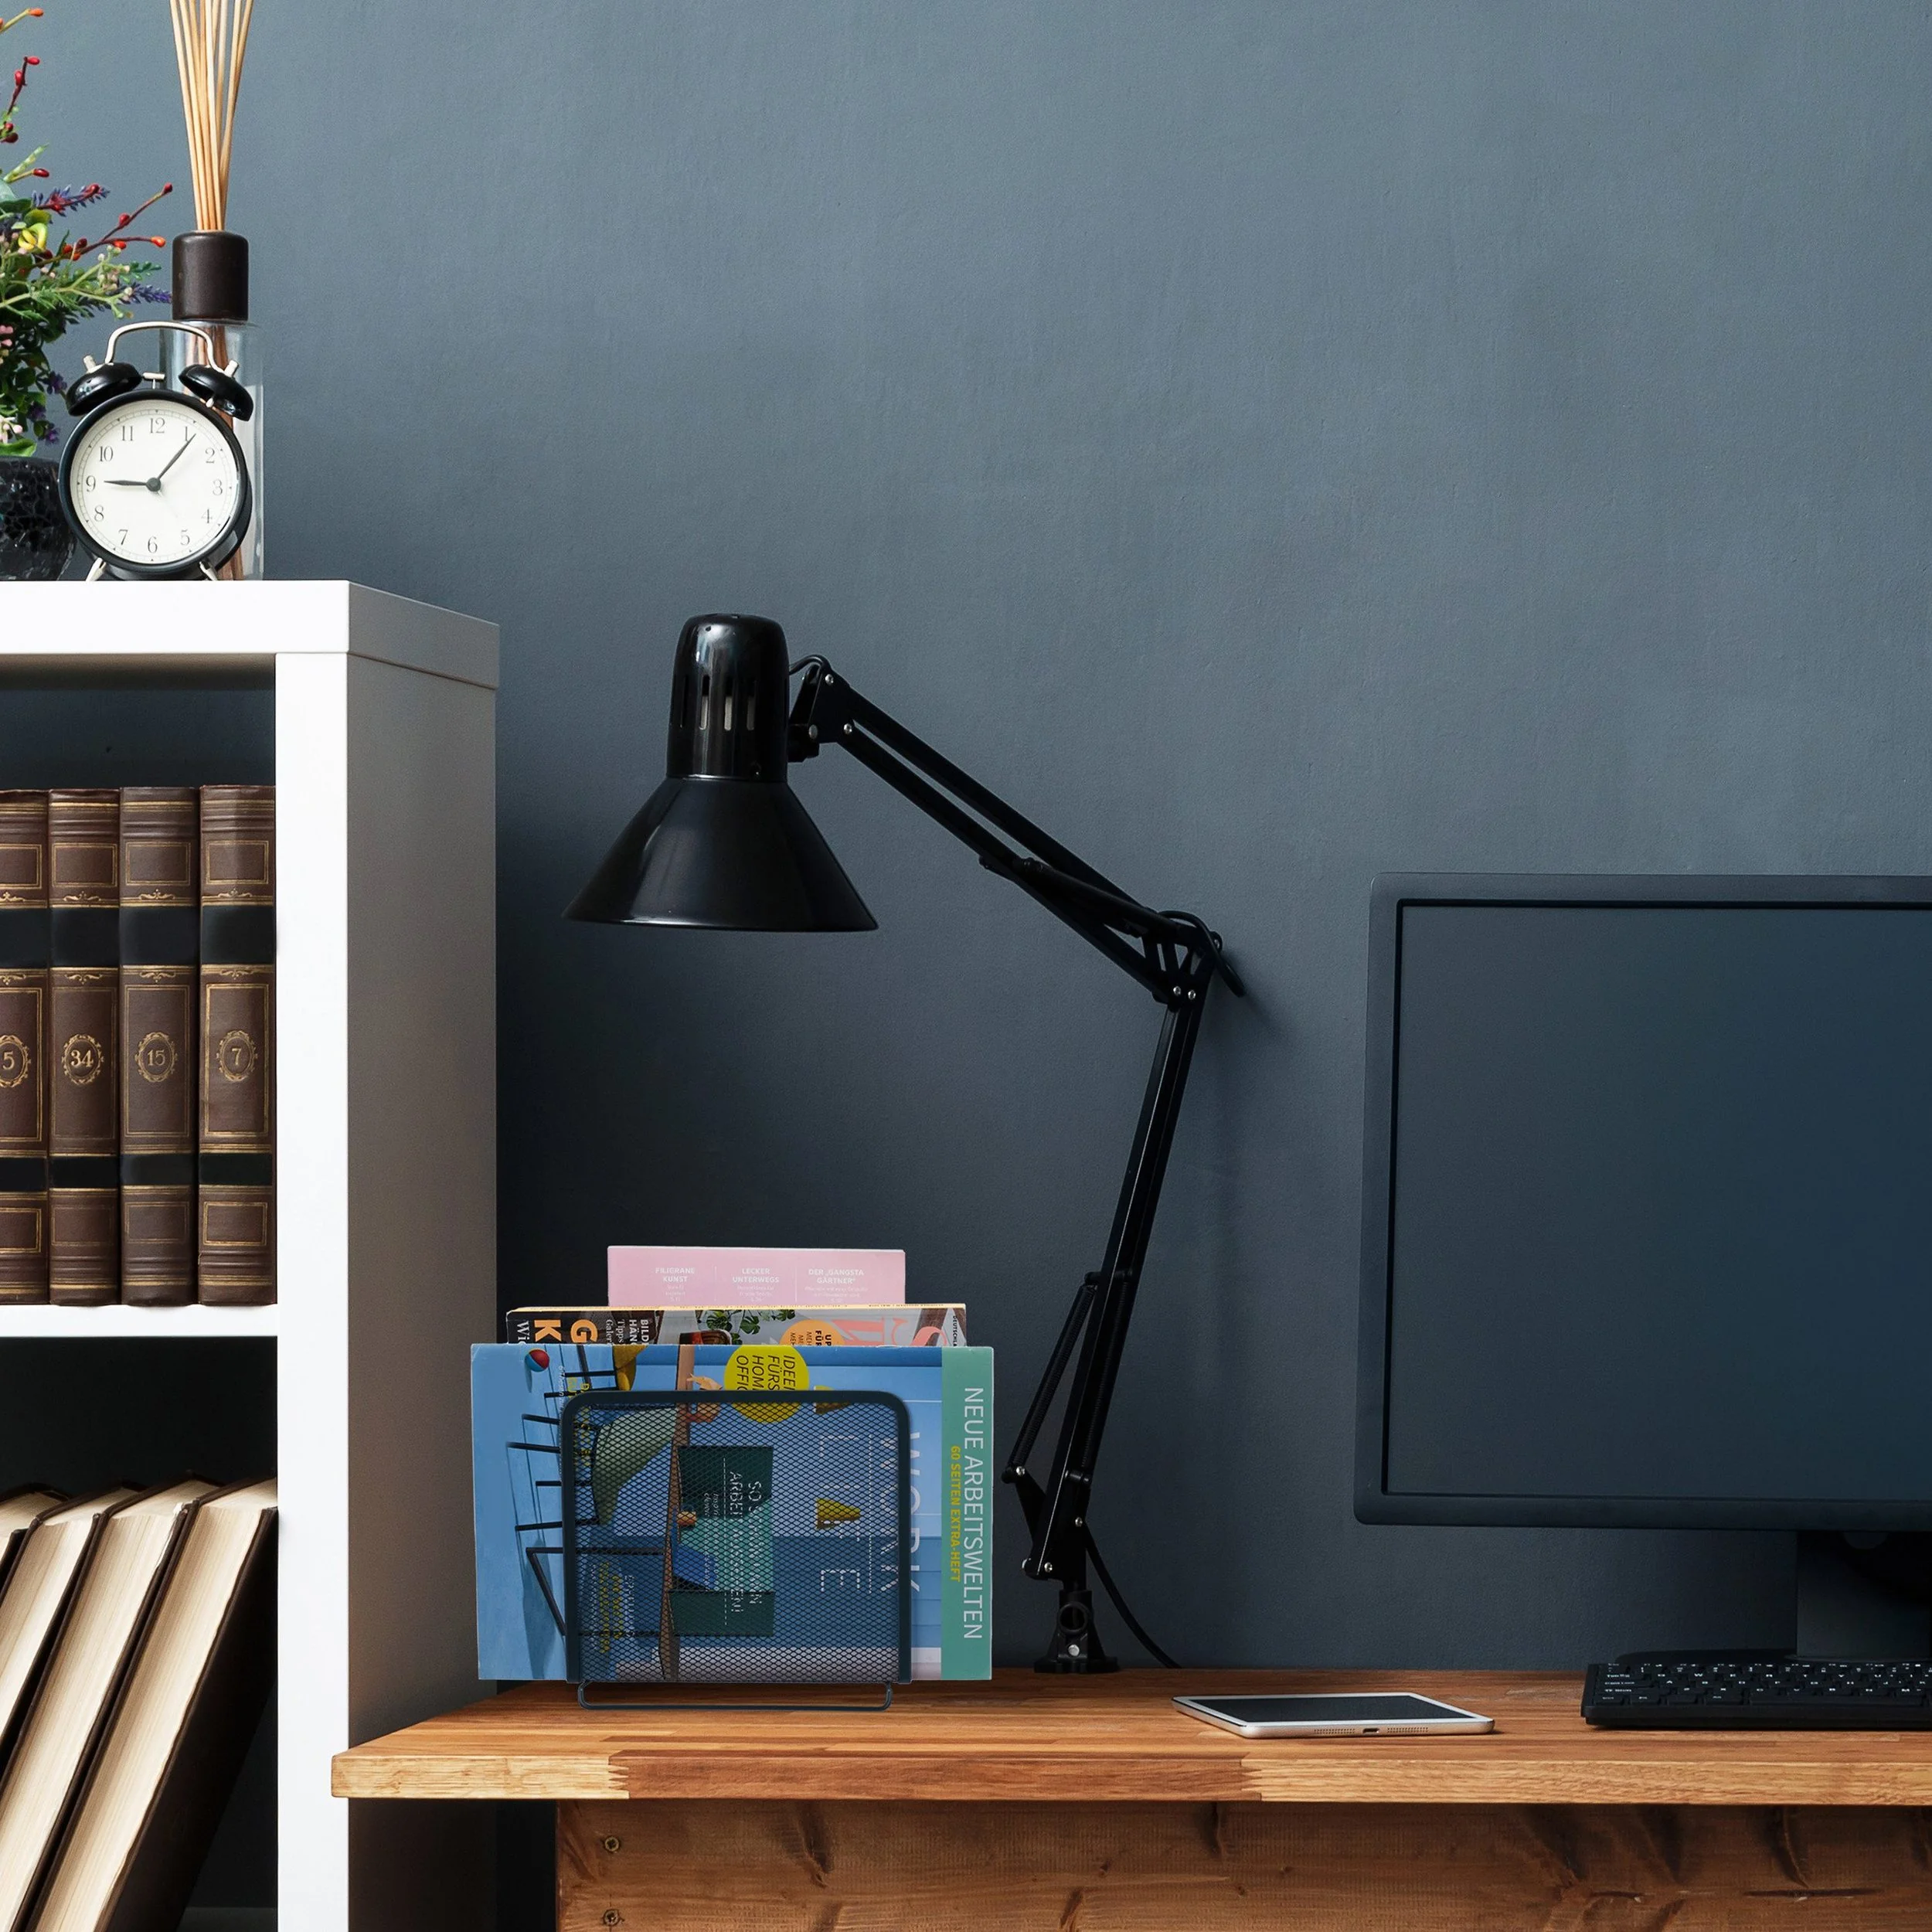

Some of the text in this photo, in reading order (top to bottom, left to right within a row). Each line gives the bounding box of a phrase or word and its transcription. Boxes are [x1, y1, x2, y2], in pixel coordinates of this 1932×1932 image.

[121, 425, 134, 441] 11
[149, 417, 165, 434] 12
[185, 426, 189, 441] 1
[100, 446, 114, 462] 10
[205, 447, 215, 464] 2
[86, 475, 96, 492] 9
[213, 479, 223, 495] 3
[94, 505, 104, 522] 8
[201, 509, 213, 524] 4
[118, 529, 128, 546] 7
[148, 536, 158, 553] 6
[180, 529, 190, 546] 5
[2, 1051, 15, 1070] 5
[70, 1049, 94, 1068] 34
[147, 1049, 166, 1066] 15
[231, 1047, 242, 1066] 7
[629, 1319, 641, 1345] HÄN
[640, 1319, 649, 1345] BILD
[752, 1355, 764, 1390] HOM
[767, 1355, 782, 1390] FÜRS
[783, 1355, 795, 1390] IDEE
[951, 1464, 961, 1505] SEITEN
[964, 1388, 984, 1638] NEUE ARBEITSWELTEN
[950, 1509, 961, 1582] EXTRA-HEFT
